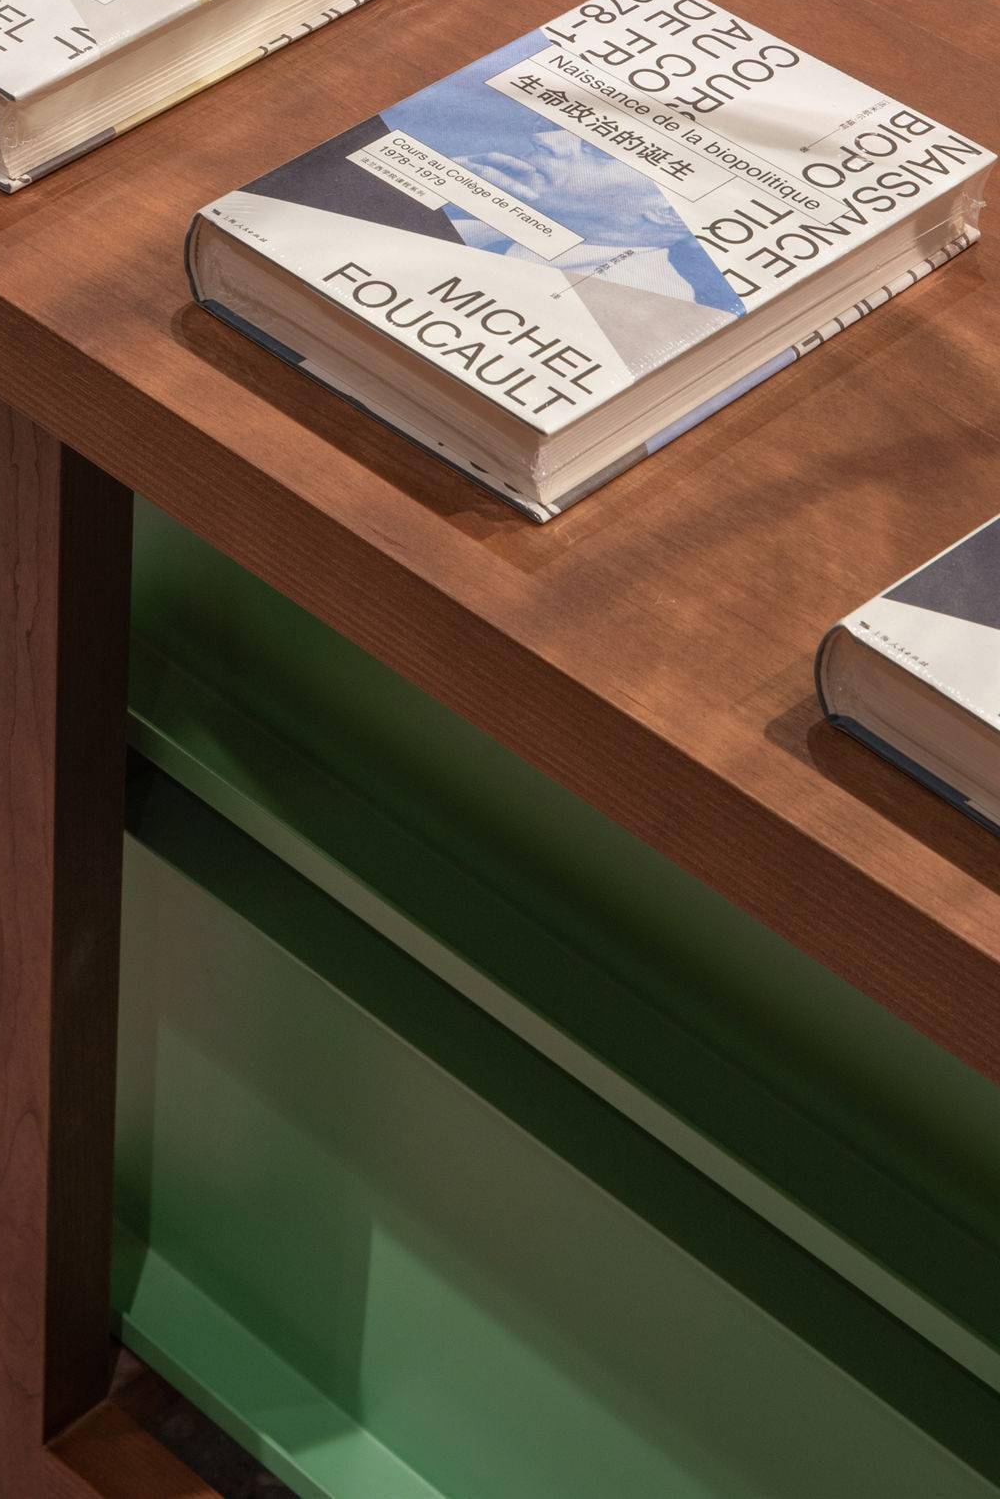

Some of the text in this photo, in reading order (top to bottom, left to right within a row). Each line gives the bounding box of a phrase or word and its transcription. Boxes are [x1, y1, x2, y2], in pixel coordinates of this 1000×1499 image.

[628, 19, 753, 92] AU CO
[511, 76, 693, 180] 生命政治的诞生
[549, 55, 819, 209] Naissance de la biopolitique
[392, 138, 552, 237] Cours au Collège de France,
[747, 136, 980, 277] NAISSANCE
[324, 263, 575, 413] FOUCAULT
[429, 277, 600, 394] MICHEL
